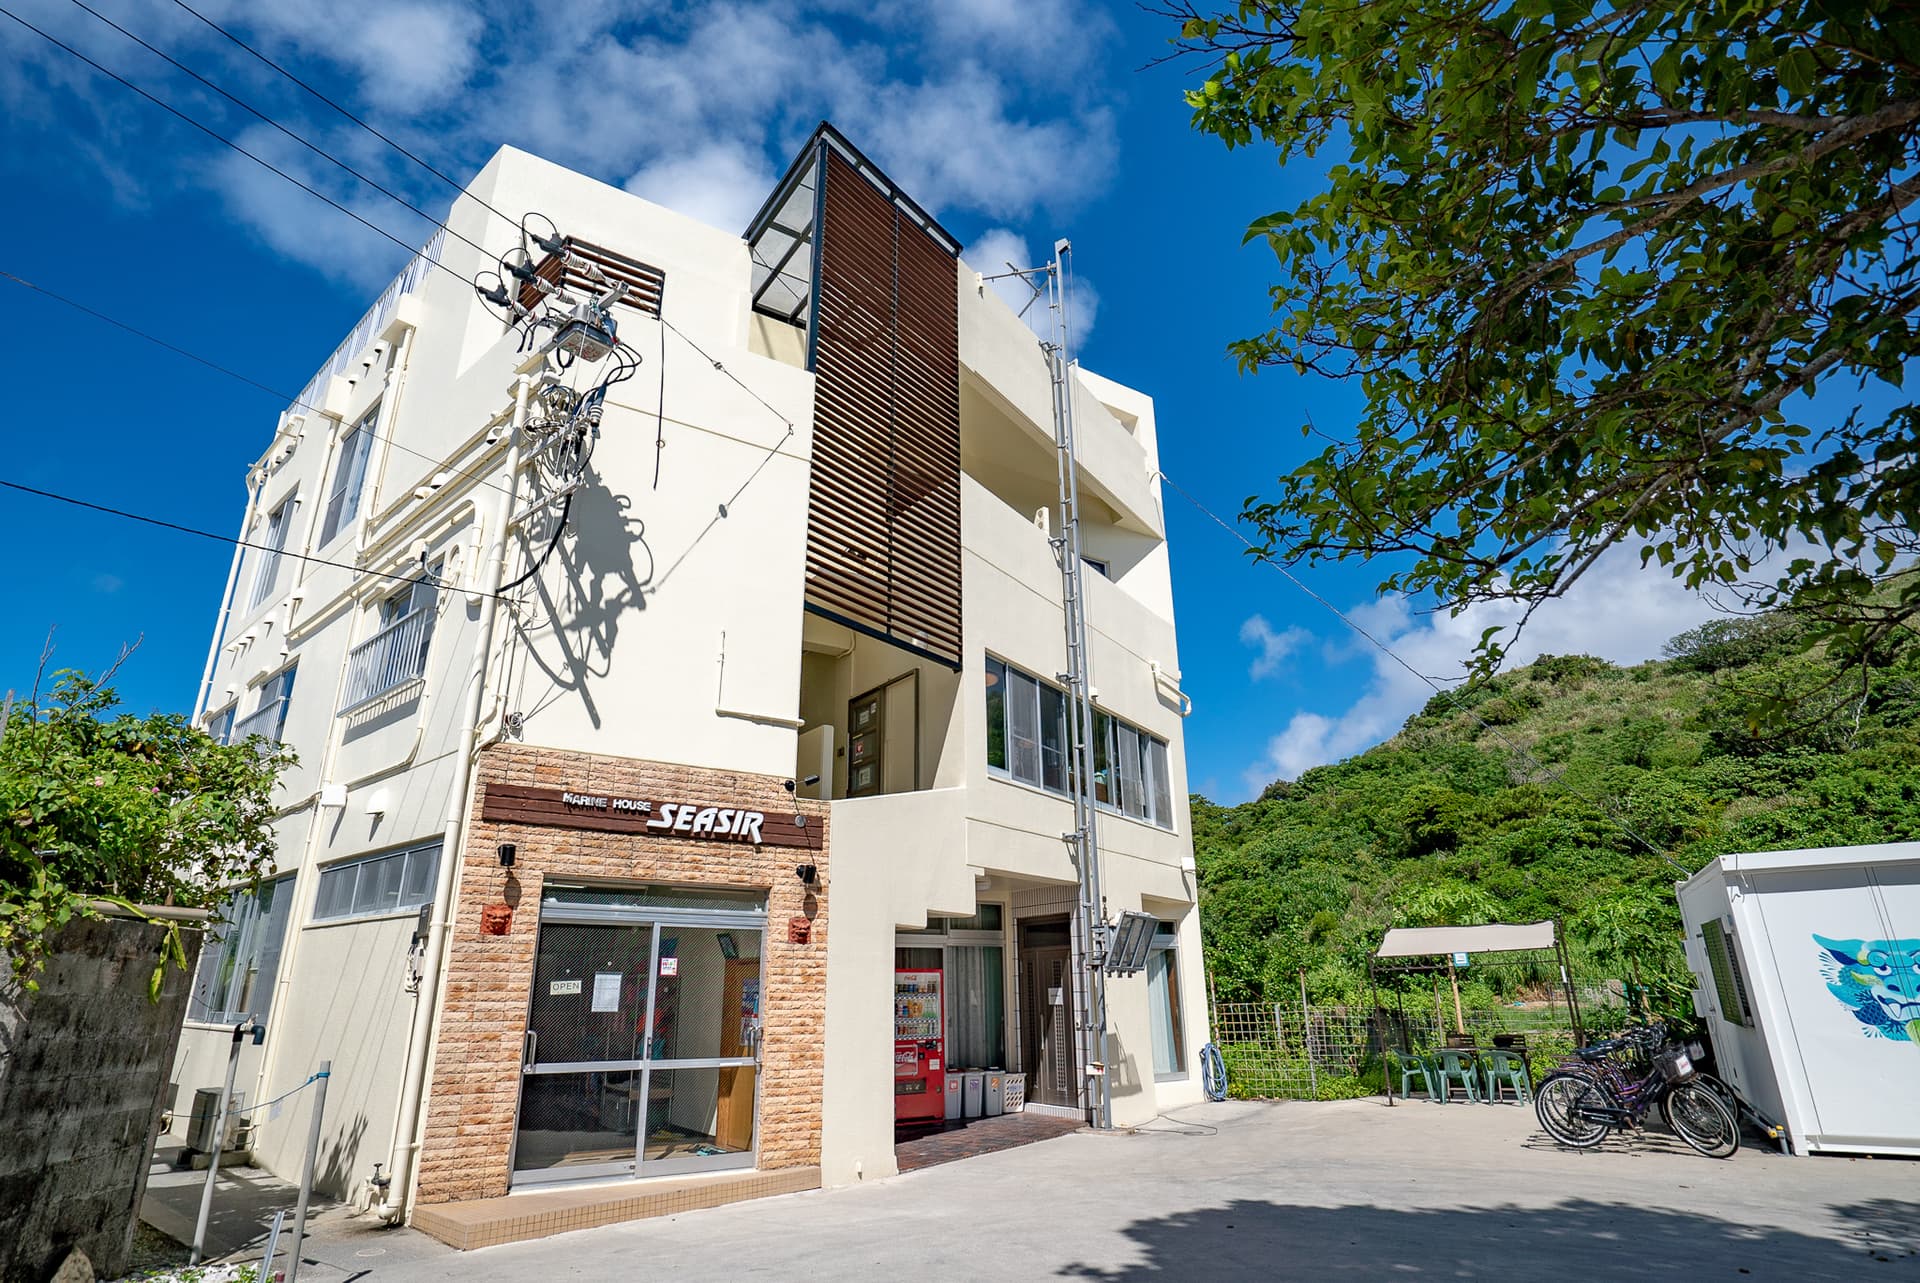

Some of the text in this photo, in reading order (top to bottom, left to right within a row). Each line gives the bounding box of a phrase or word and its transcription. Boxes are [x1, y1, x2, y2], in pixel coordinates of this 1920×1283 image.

[562, 792, 764, 844] MARINE HOUSE SEASIR
[552, 982, 580, 991] OPEN
